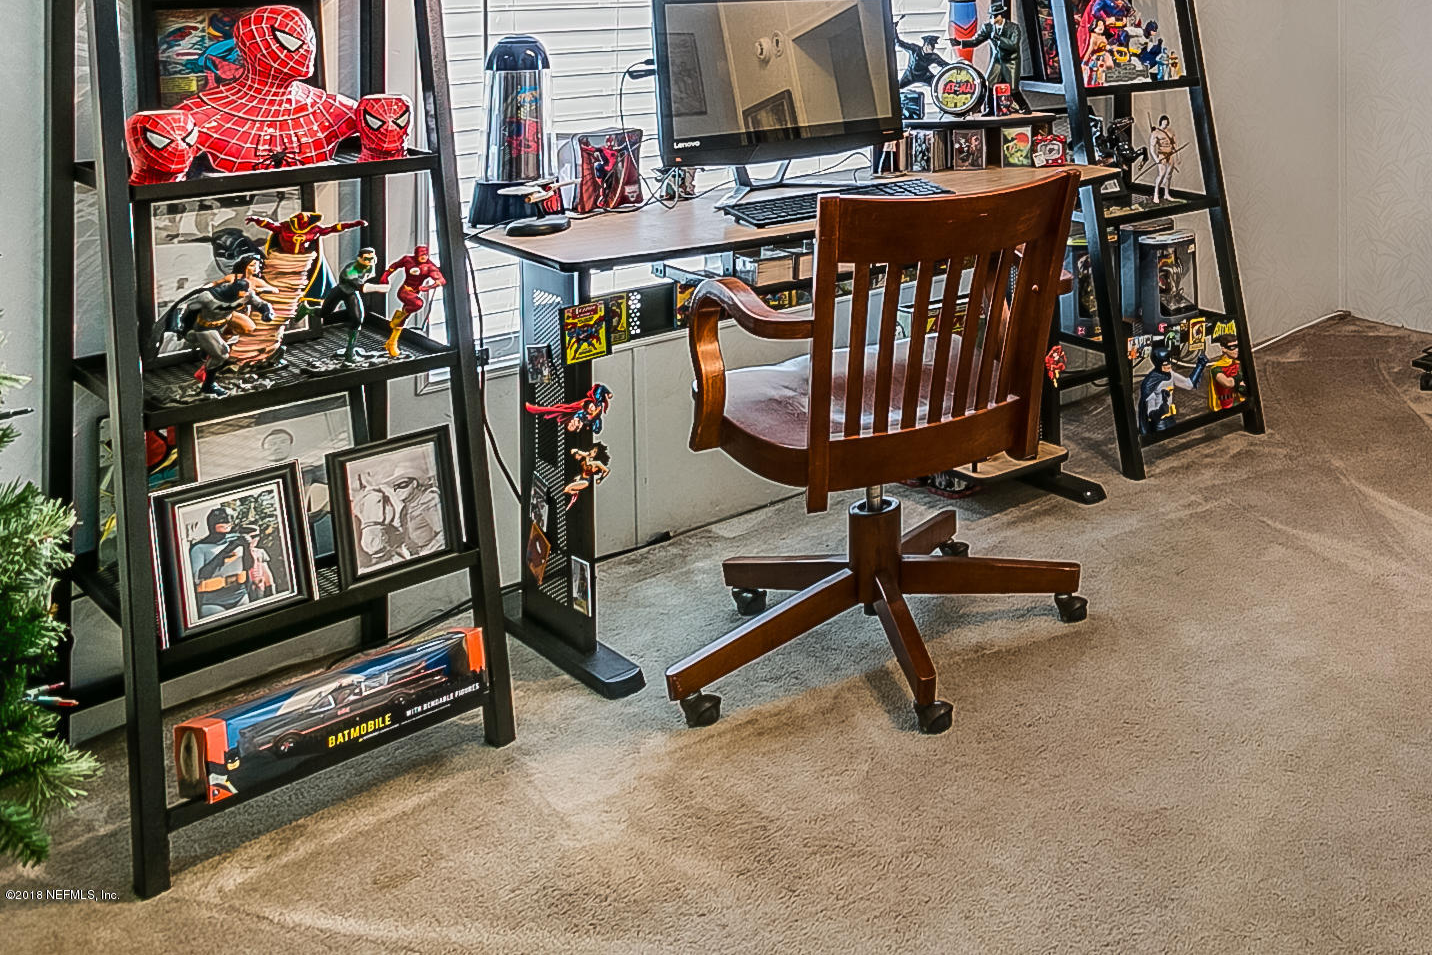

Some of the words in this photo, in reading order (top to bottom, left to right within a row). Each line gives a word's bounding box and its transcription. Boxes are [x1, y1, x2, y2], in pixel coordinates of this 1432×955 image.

[674, 140, 701, 150] Lenovo
[406, 704, 422, 717] WITH
[423, 694, 454, 711] BENDABLE
[455, 682, 480, 698] FIGURES
[328, 713, 392, 748] BATMOBILE
